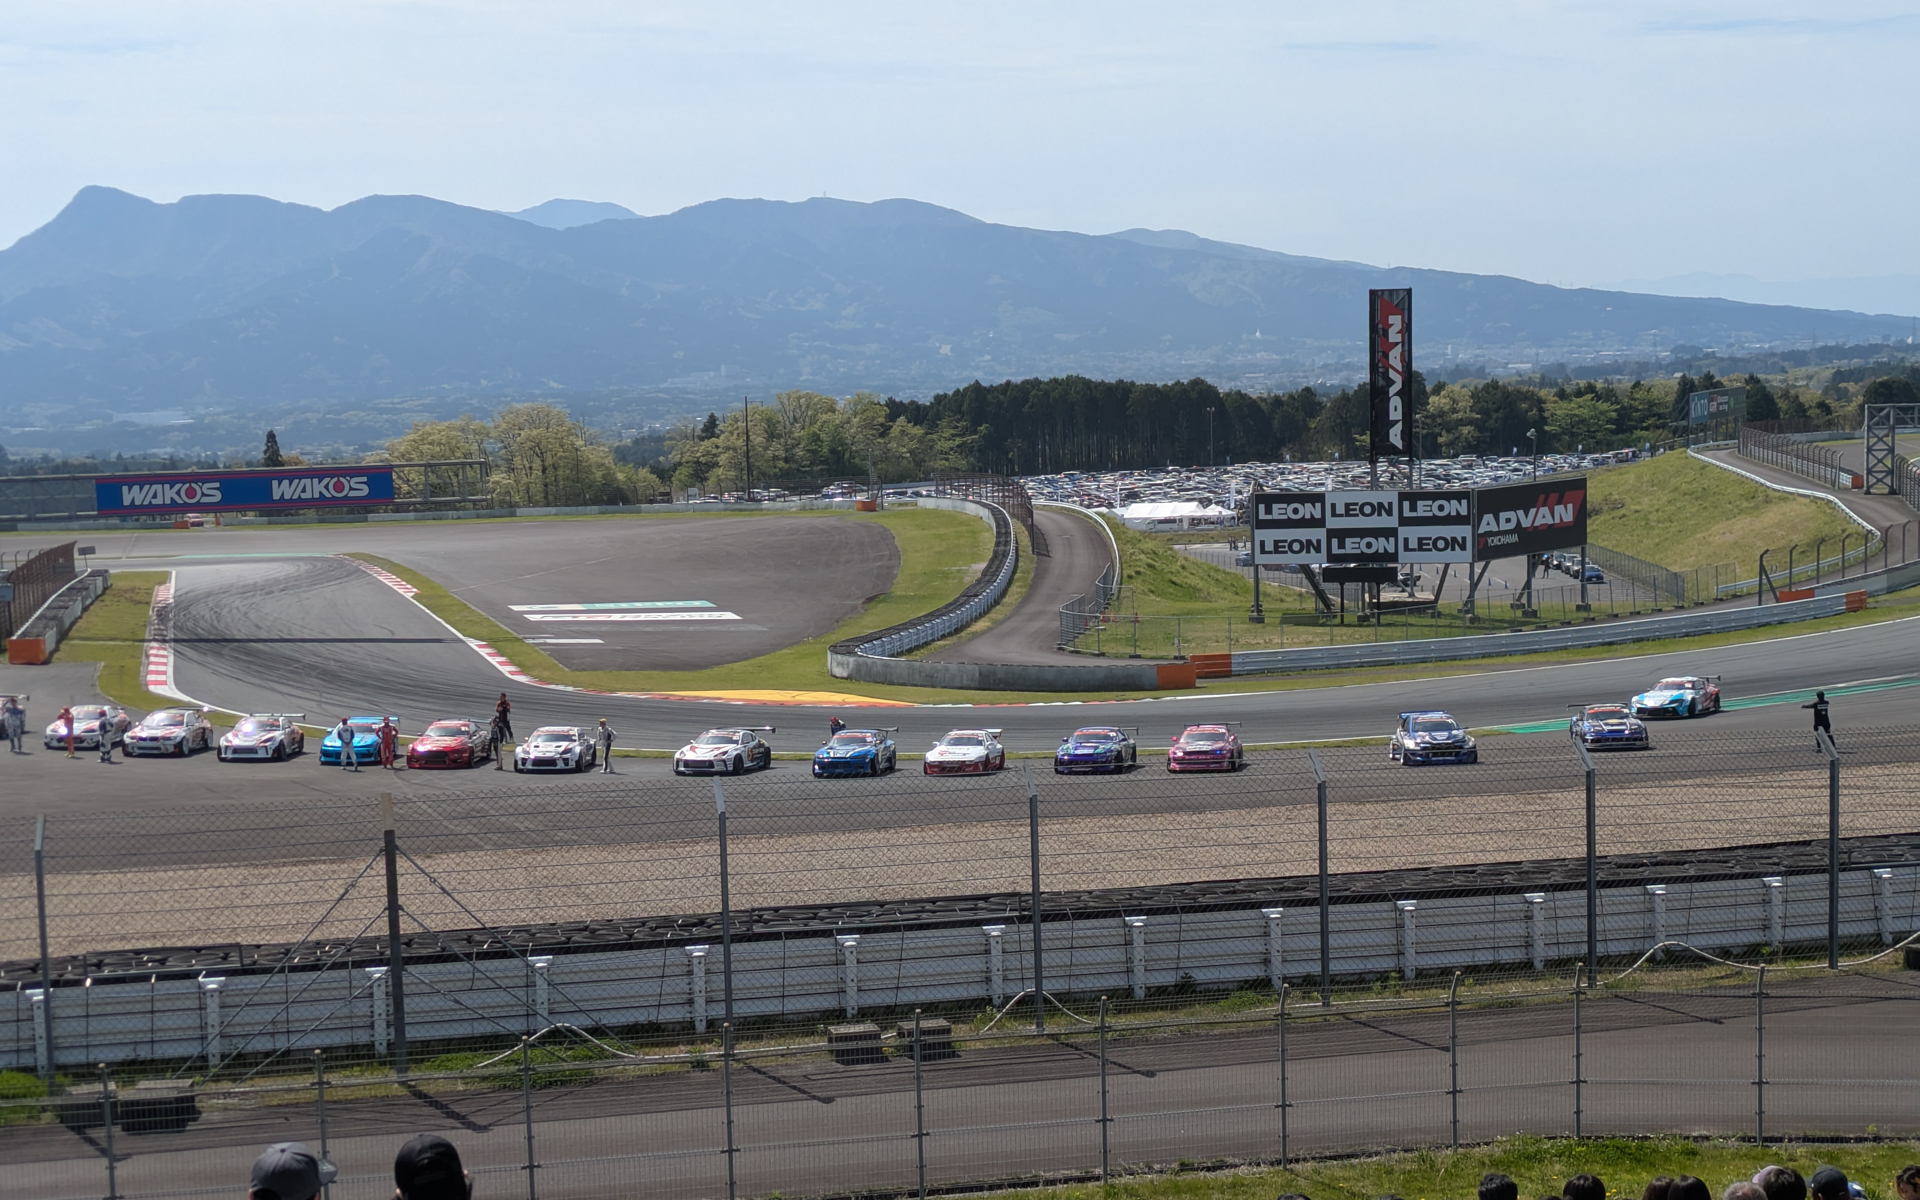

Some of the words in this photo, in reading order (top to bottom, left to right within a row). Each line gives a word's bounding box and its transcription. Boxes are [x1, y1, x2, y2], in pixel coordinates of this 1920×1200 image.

[1388, 314, 1402, 450] ADVAN
[121, 480, 223, 506] WAKO'S
[271, 475, 370, 500] WAKO'S
[1258, 502, 1322, 520] LEON
[1330, 500, 1394, 518] LEON
[1402, 499, 1468, 517] LEON
[1477, 503, 1573, 533] ADVAN
[1259, 538, 1322, 555] LEON
[1331, 536, 1396, 555] LEON
[1402, 535, 1467, 553] LEON
[1487, 533, 1519, 547] YOKOHAMA
